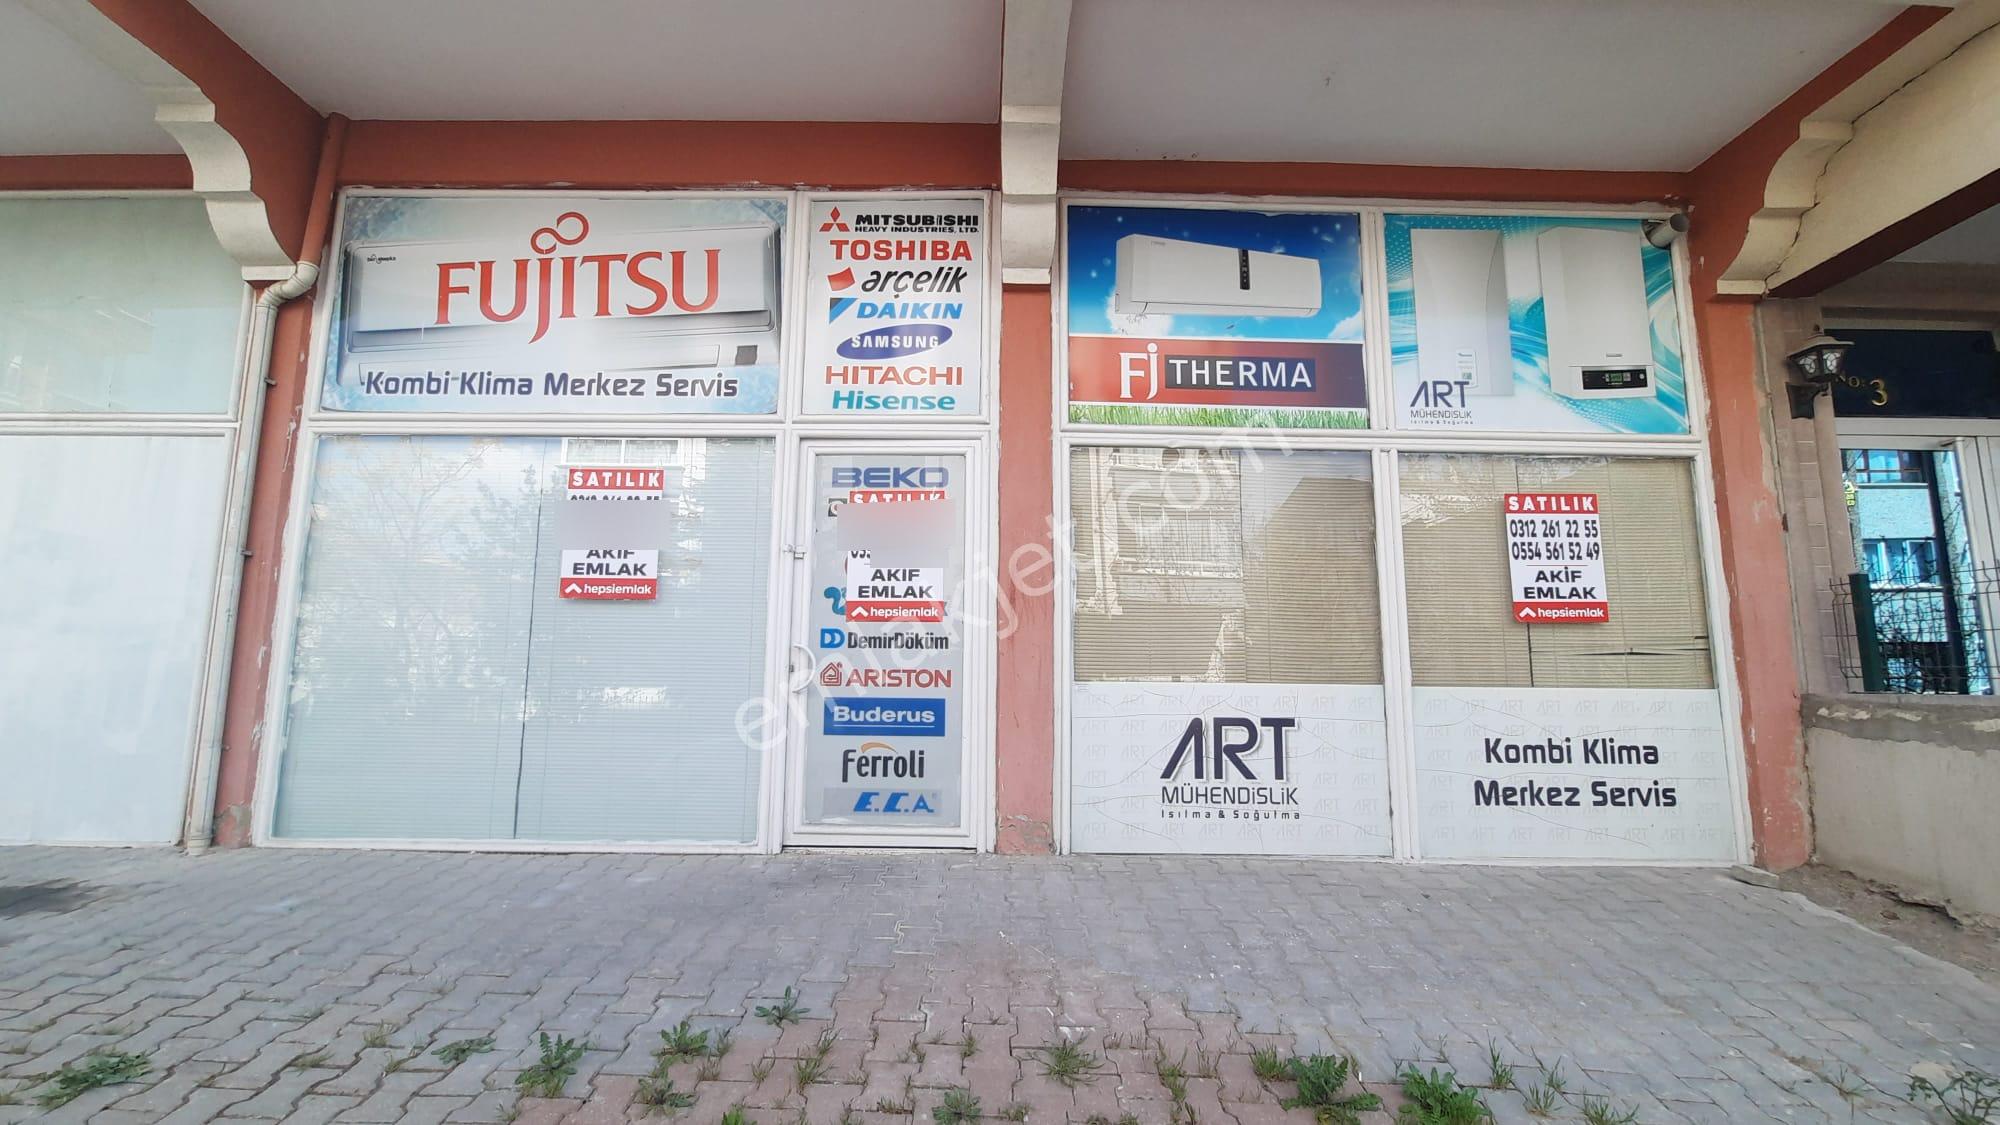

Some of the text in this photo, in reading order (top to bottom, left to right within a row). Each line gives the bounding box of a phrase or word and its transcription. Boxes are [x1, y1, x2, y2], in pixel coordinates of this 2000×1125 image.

[855, 214, 979, 226] MITSUBISHI
[829, 240, 973, 261] TOSHIBA
[861, 266, 968, 299] arçelik
[434, 249, 721, 344] FUJITSU
[856, 302, 963, 320] DAIKIN
[851, 335, 940, 348] SAMSUNG
[825, 366, 963, 386] HITACHI
[1169, 359, 1313, 389] THERMA
[544, 371, 646, 397] Merkez
[655, 371, 738, 398] Servis
[1410, 380, 1470, 408] ART
[1870, 379, 1888, 406] 3
[832, 390, 956, 411] Hisense
[572, 471, 661, 487] SATILIK
[831, 467, 949, 488] BEKO
[1508, 496, 1595, 511] SATILIK
[1509, 519, 1599, 538] 0312 261 22 55
[1511, 541, 1600, 560] 0554 561 52 49
[572, 563, 647, 576] EMLAK
[583, 584, 652, 595] hepsiemlak
[858, 586, 933, 599] EMLAK
[1523, 587, 1597, 599] EMLAK
[870, 606, 939, 618] hepsiemlak
[1538, 607, 1605, 619] hepsiemlak
[847, 632, 949, 650] DemirDöküm
[845, 669, 952, 688] ARISTON
[833, 706, 936, 723] Buderus
[1160, 716, 1296, 781] ART
[1484, 736, 1573, 764] Kombi
[1582, 736, 1660, 765] Klima
[842, 749, 925, 783] Ferroli
[1473, 779, 1581, 806] Merkez
[1590, 779, 1678, 807] Servis
